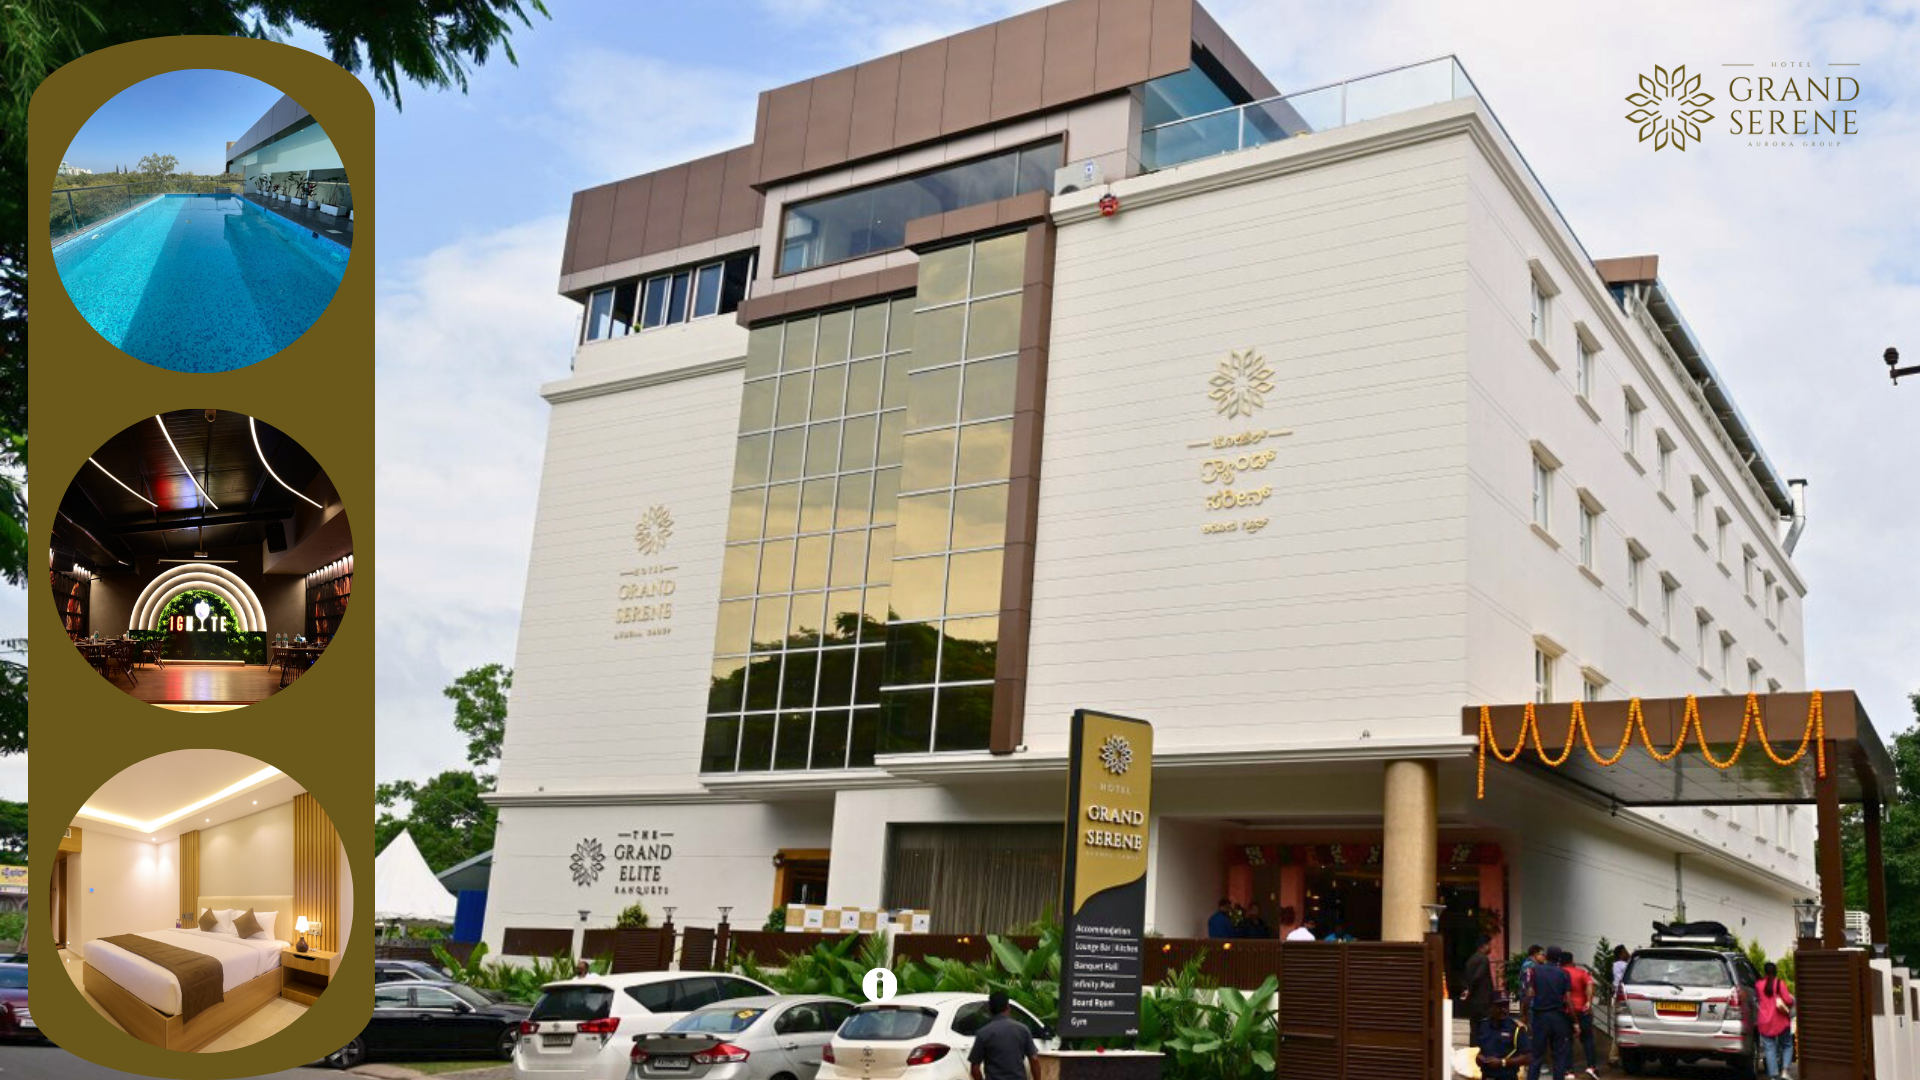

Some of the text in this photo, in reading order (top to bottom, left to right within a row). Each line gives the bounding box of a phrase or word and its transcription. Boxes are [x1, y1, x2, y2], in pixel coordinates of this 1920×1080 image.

[618, 579, 676, 600] GRAND
[1087, 805, 1144, 825] GRAND
[633, 830, 658, 840] THE
[1086, 829, 1143, 850] SERENE
[614, 844, 672, 860] GRAND
[619, 866, 661, 882] ELITE
[614, 886, 669, 896] BANQUETS
[1075, 924, 1131, 936] Accommodation
[1075, 942, 1099, 953] Lounge
[1100, 943, 1111, 952] Bar
[1115, 944, 1139, 953] Kitchen
[1073, 961, 1119, 972] Banquet Hall
[1072, 980, 1115, 990] Infinity Pool
[1072, 998, 1115, 1008] Board Room
[1071, 1017, 1087, 1027] Gym
